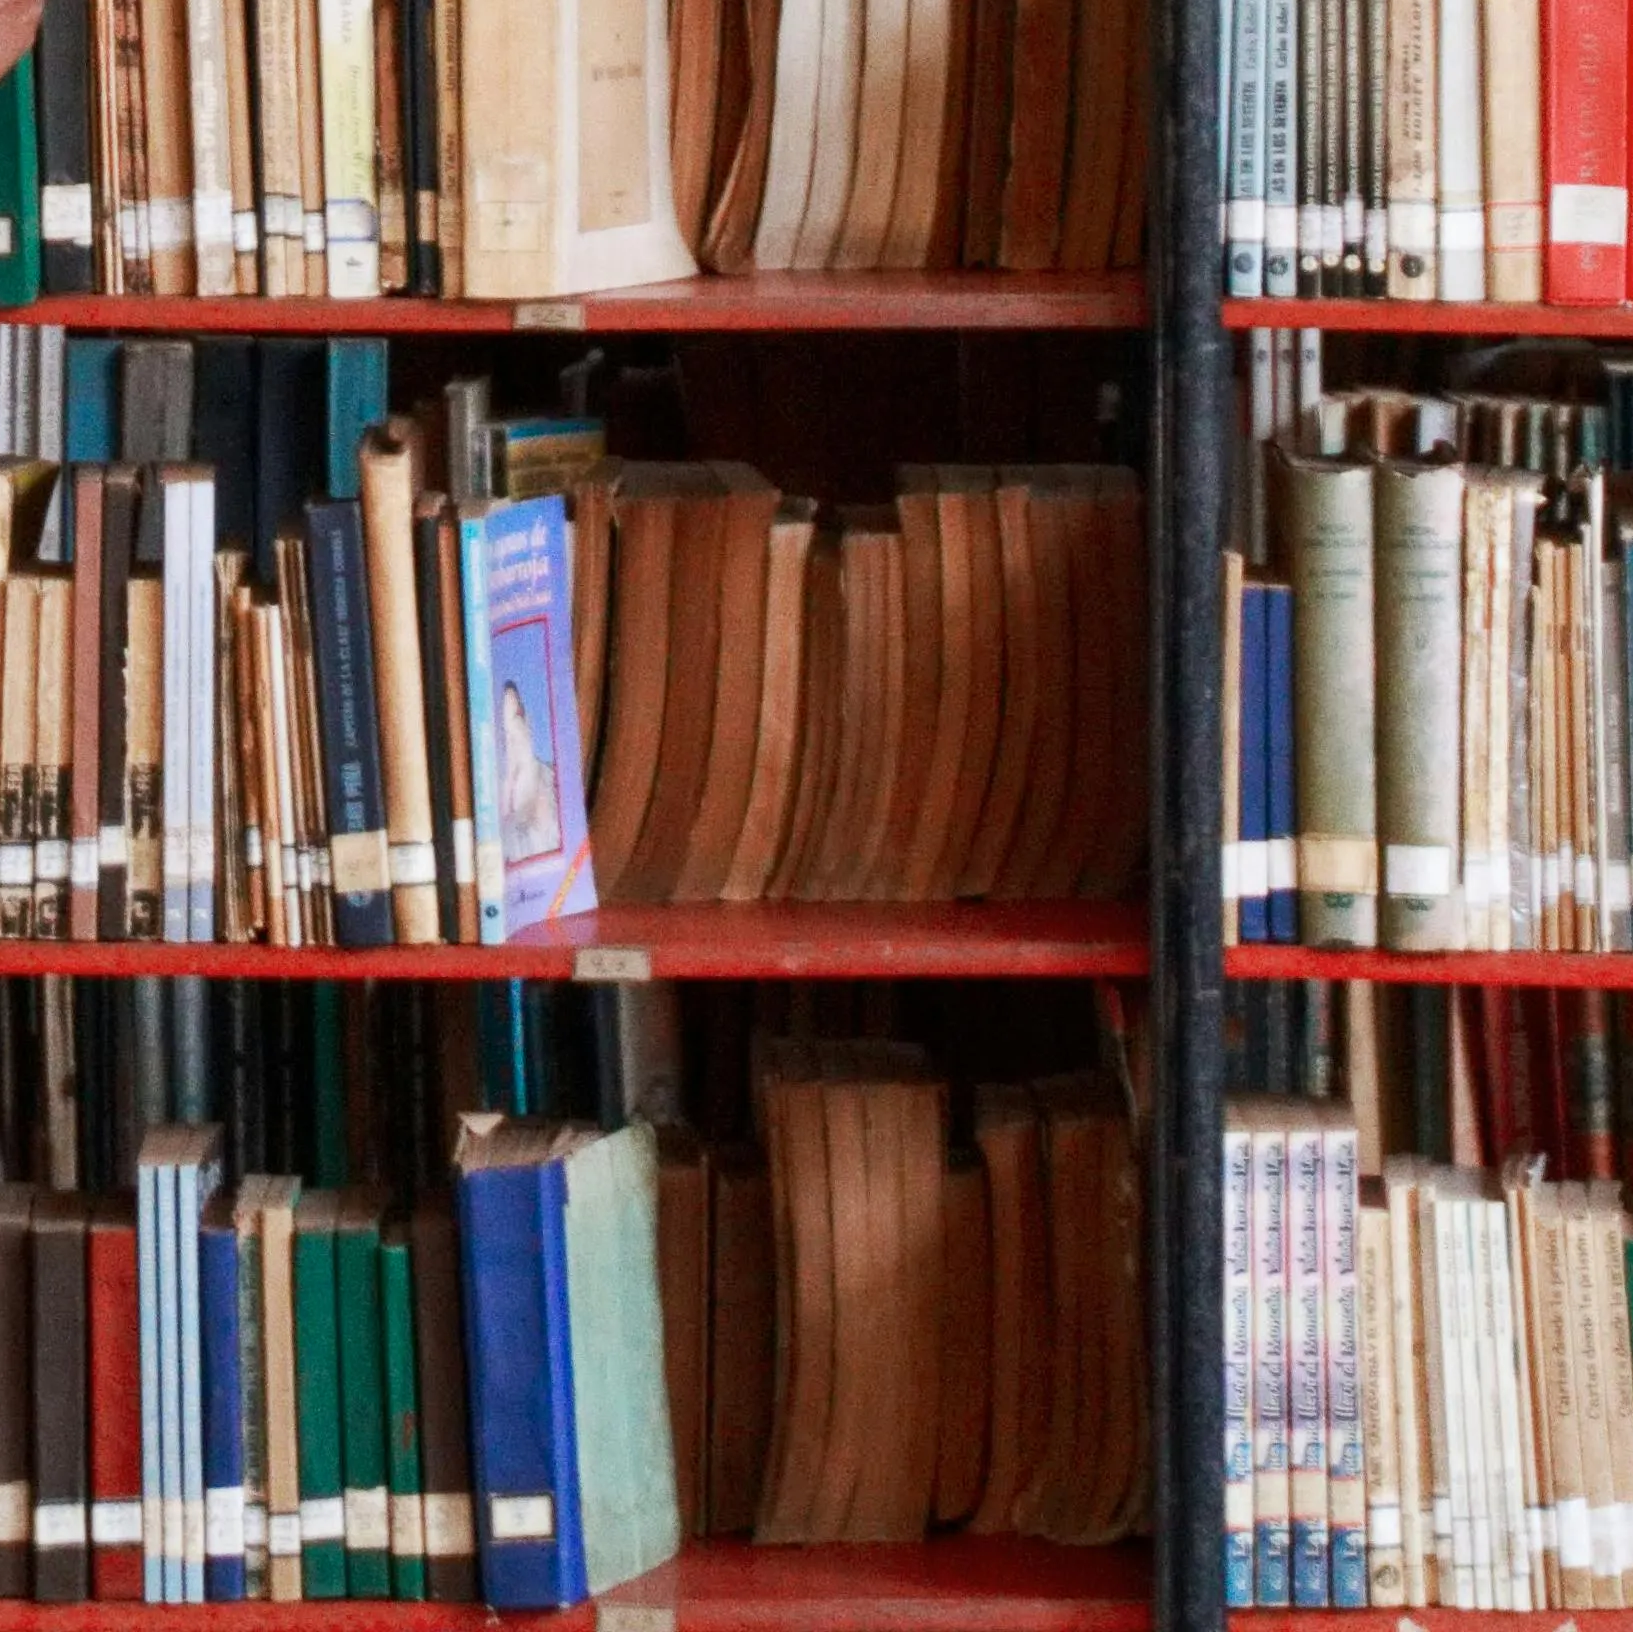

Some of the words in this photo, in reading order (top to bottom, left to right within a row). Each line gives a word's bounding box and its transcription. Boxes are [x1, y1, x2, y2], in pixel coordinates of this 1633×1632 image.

[1274, 3, 1288, 35] Rafael
[1273, 37, 1287, 70] Carlos
[1272, 80, 1287, 129] SETENTA
[1272, 132, 1287, 155] LOS
[1272, 159, 1287, 175] EN
[1555, 1360, 1571, 1417] Cartas
[1584, 1363, 1600, 1420] Cartas
